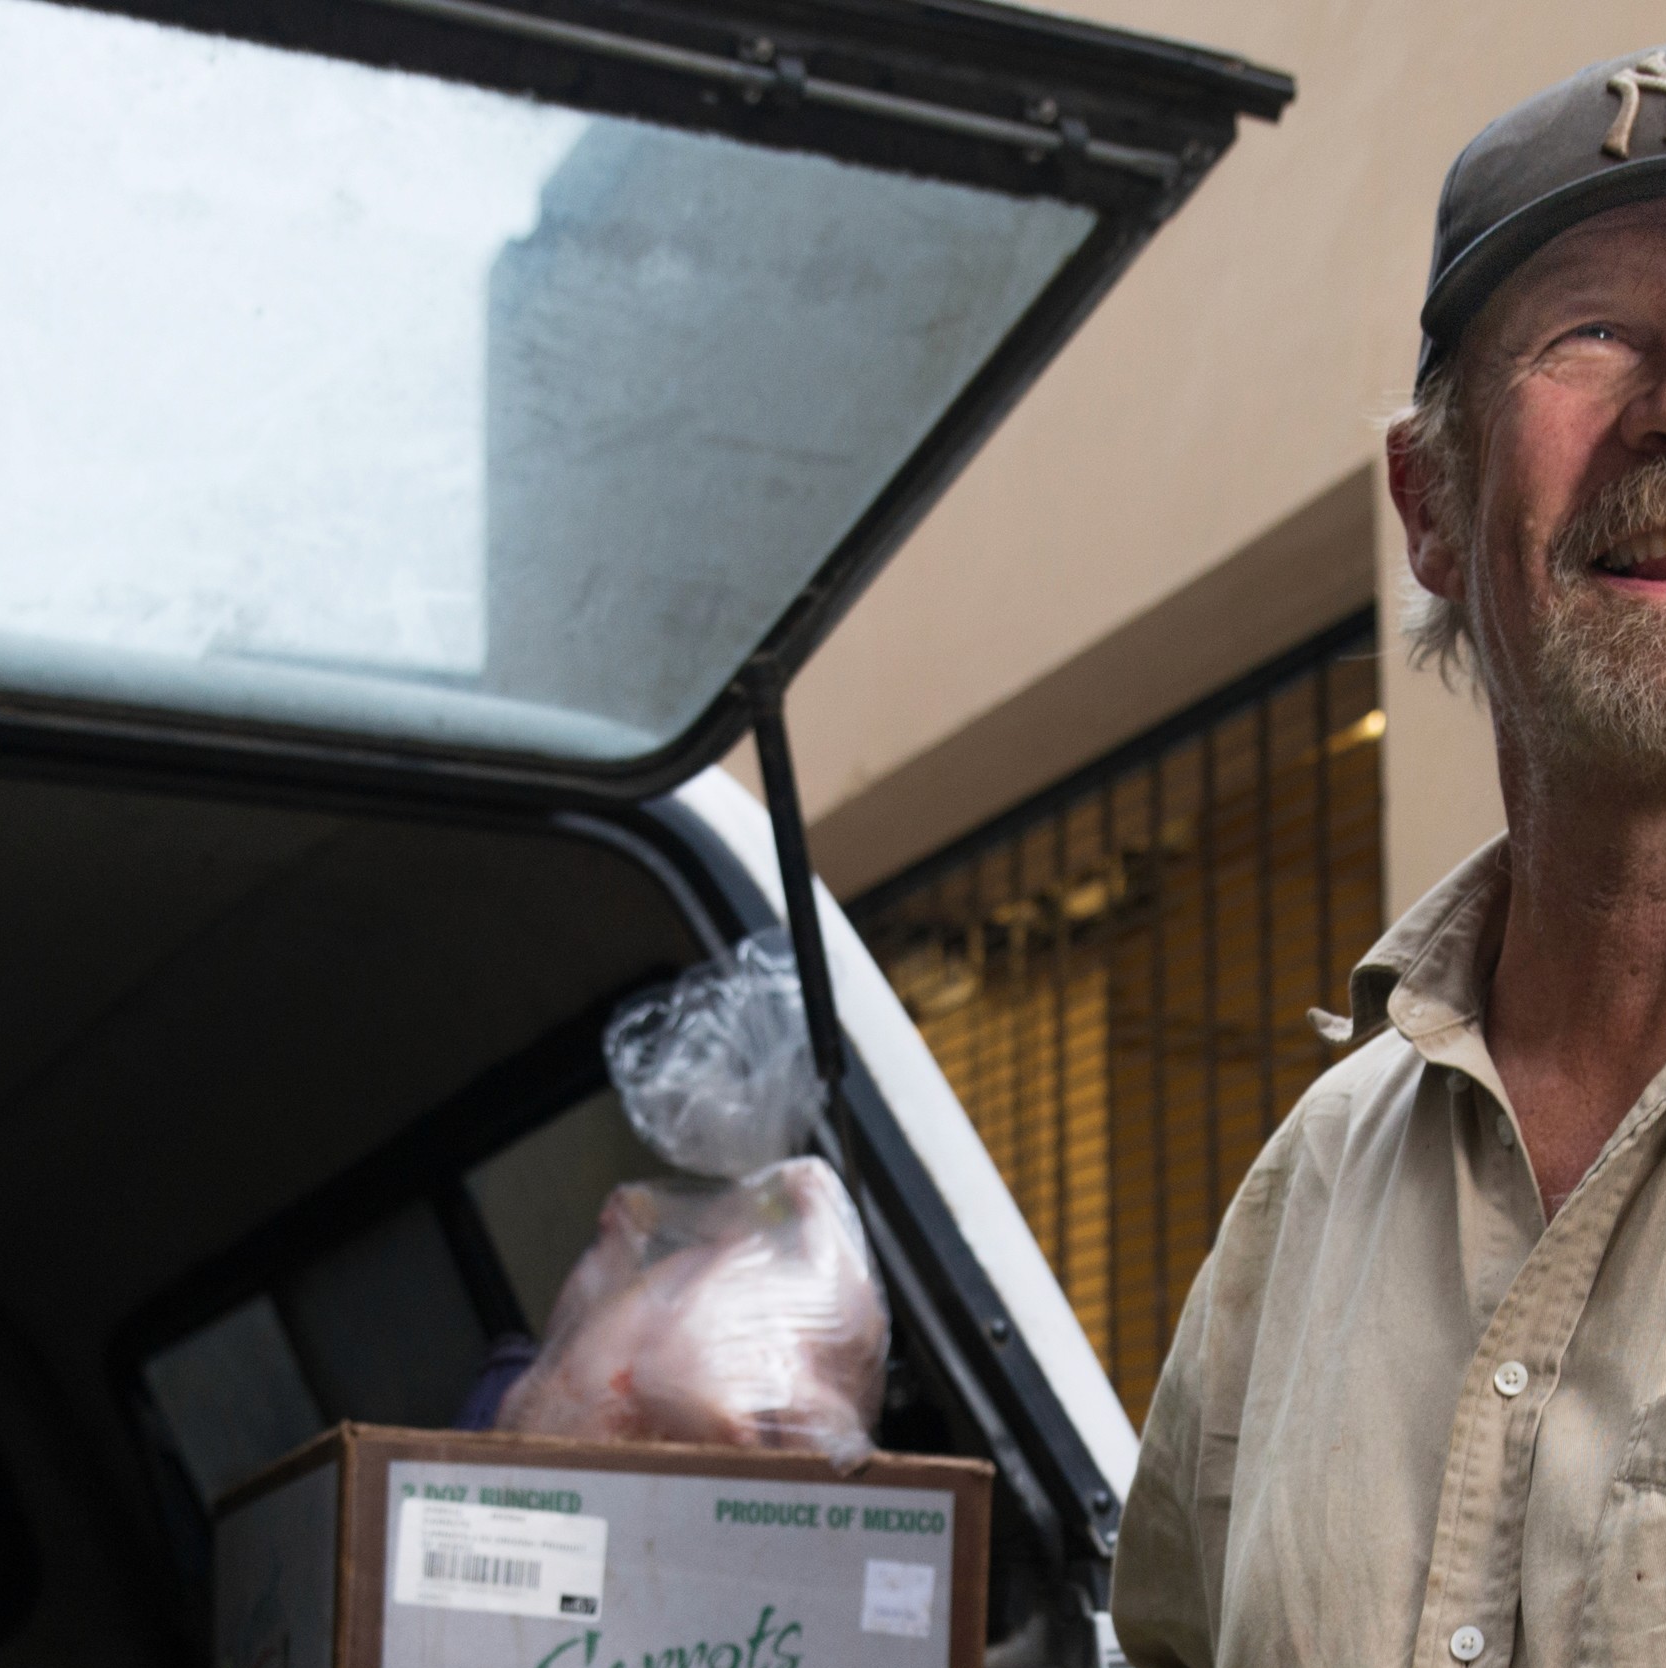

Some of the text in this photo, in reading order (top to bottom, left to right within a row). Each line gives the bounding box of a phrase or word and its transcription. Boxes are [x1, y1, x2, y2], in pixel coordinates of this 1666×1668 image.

[477, 1485, 583, 1515] BUNCHED
[715, 1498, 947, 1536] PRODUCE OF MEXICO
